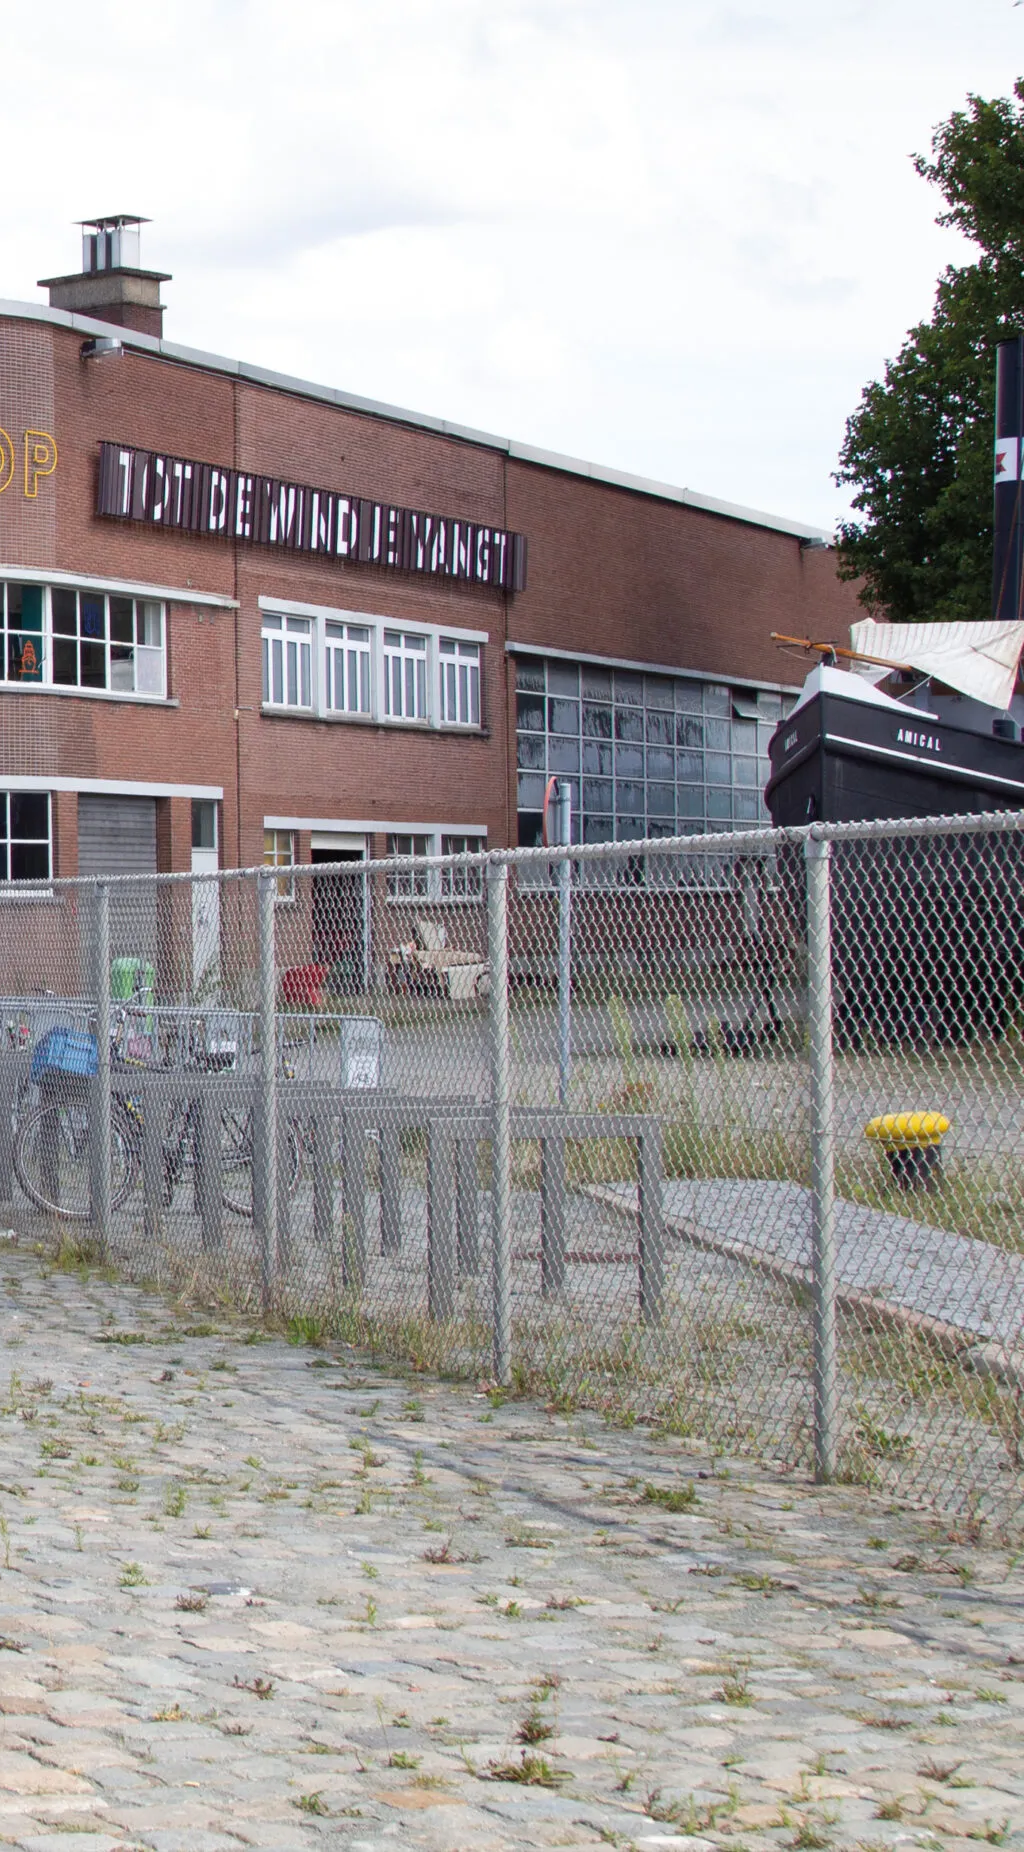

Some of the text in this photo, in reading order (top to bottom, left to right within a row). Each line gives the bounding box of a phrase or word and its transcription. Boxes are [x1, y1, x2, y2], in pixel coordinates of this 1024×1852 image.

[119, 451, 192, 524] TOT
[208, 471, 253, 537] DE
[266, 482, 358, 555] WIND
[367, 506, 400, 565] JE
[897, 728, 941, 752] AMICAL
